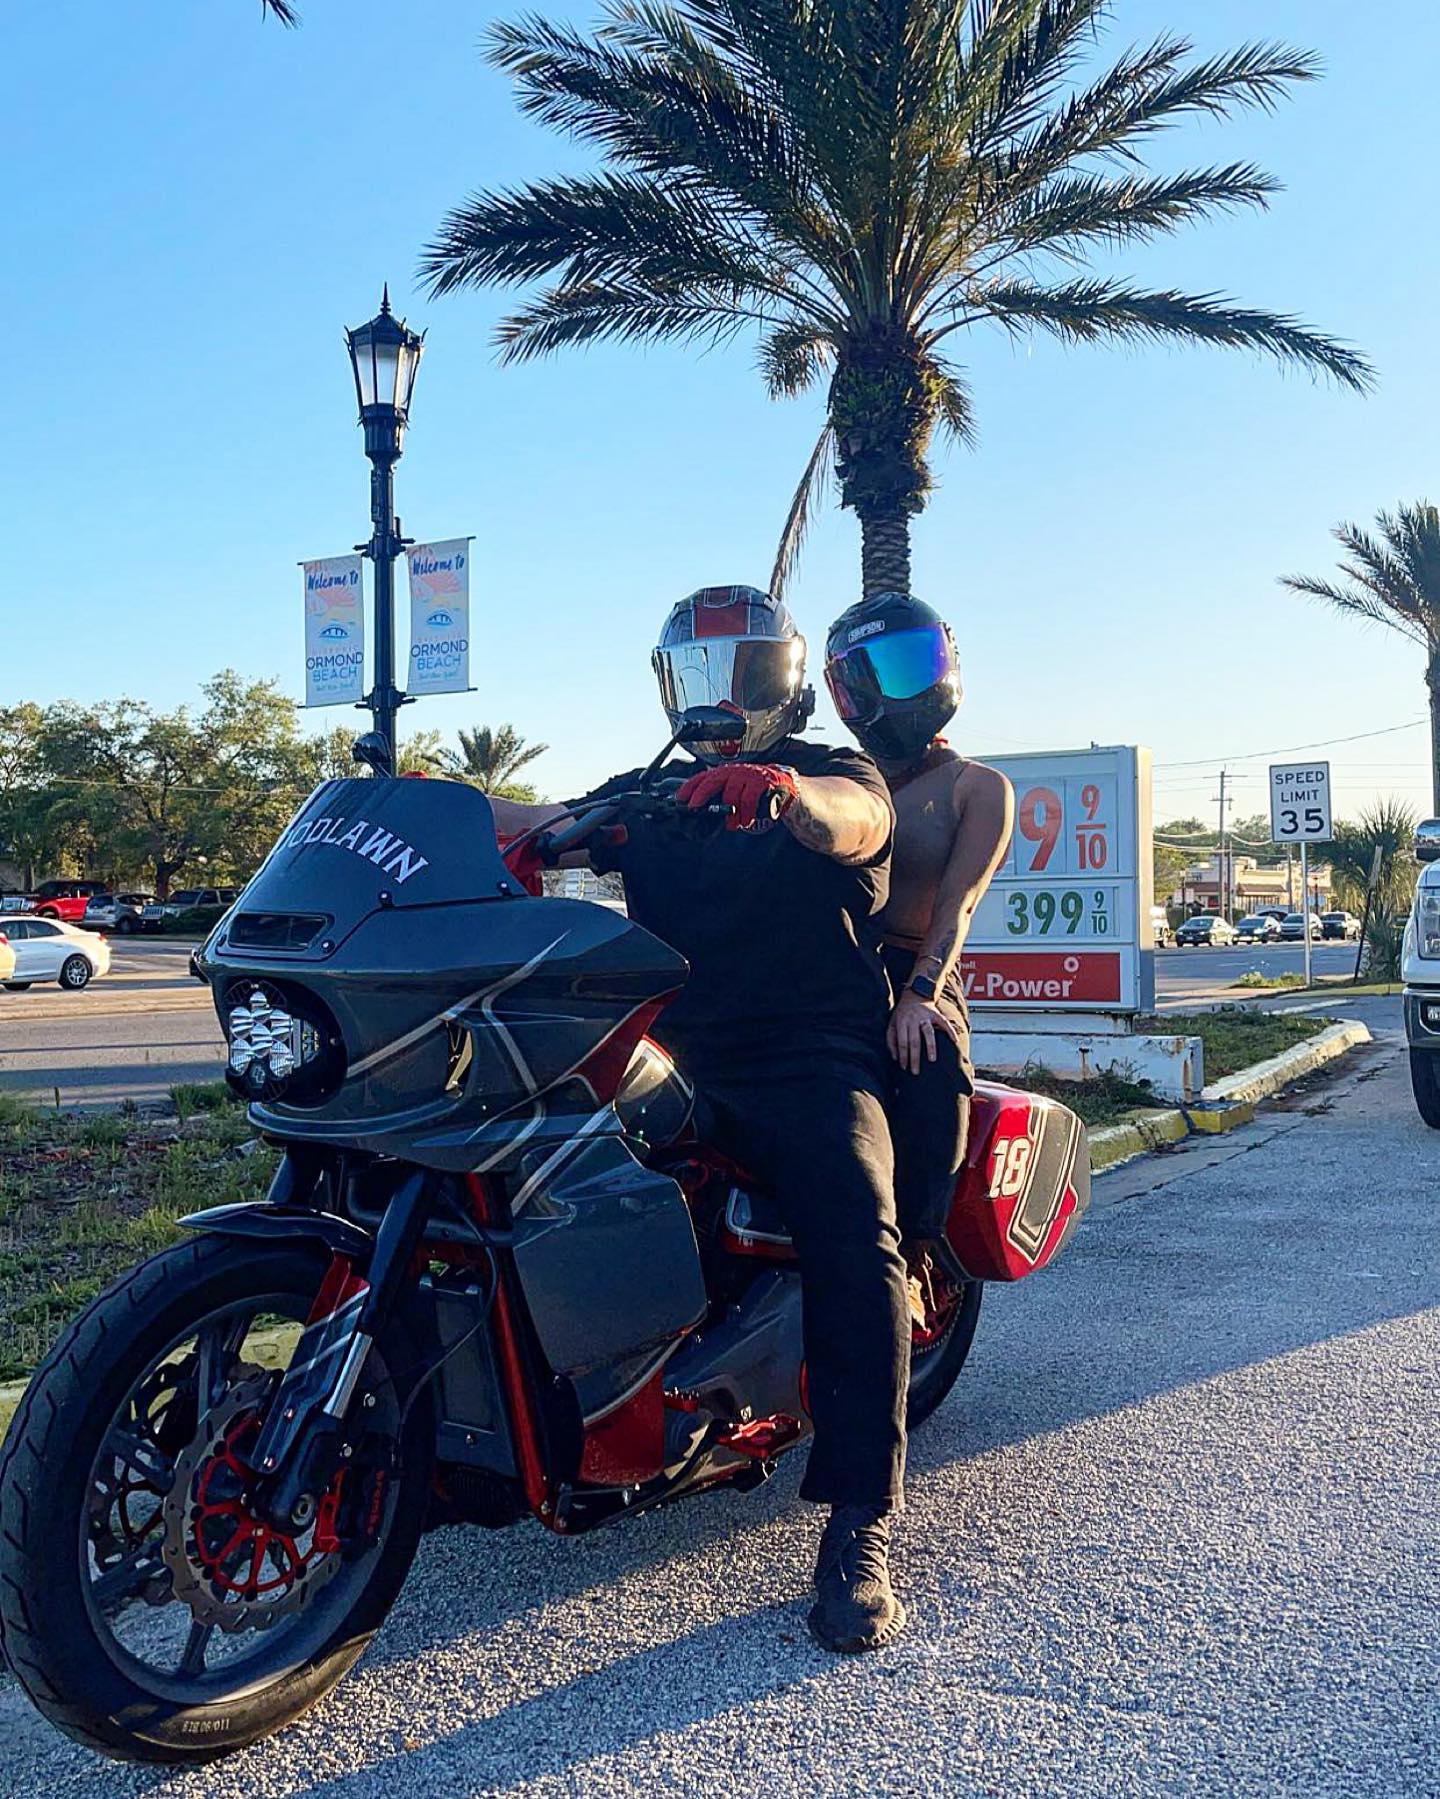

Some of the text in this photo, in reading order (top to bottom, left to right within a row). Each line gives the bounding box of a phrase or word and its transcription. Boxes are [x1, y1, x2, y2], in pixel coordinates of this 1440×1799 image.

[413, 553, 465, 576] Welcome to
[307, 569, 359, 591] Welcome to
[411, 639, 469, 657] ORMOND
[306, 652, 364, 670] ORMOND
[417, 654, 461, 670] BEACH
[313, 665, 357, 682] BEACH
[1275, 771, 1325, 785] SPEED
[1281, 789, 1320, 803] LIMIT
[1280, 807, 1325, 835] 35
[1006, 891, 1084, 935] 399
[989, 1136, 1031, 1199] 18
